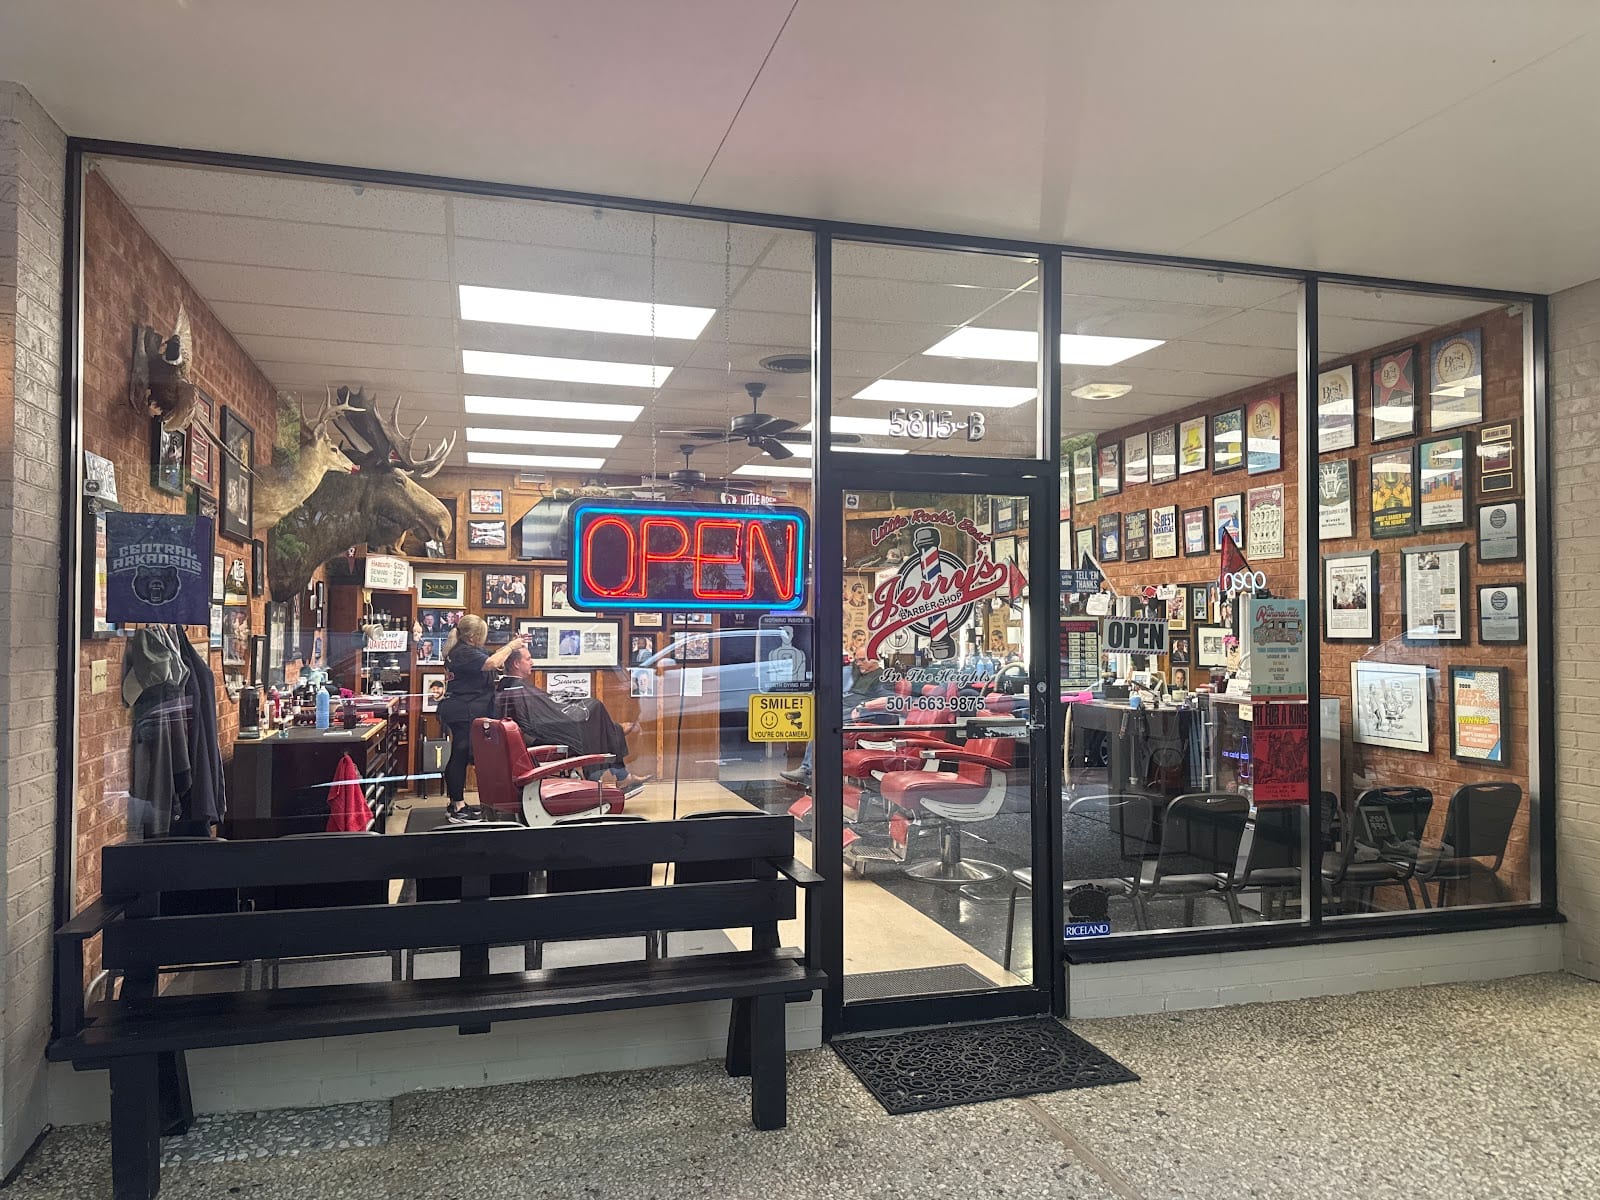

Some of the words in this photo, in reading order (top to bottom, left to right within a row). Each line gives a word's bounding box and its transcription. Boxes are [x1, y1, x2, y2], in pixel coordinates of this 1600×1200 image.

[889, 407, 985, 441] 5815-B
[740, 493, 760, 505] LITTLE
[1160, 513, 1175, 527] BEST
[871, 515, 908, 546] Little
[119, 543, 198, 561] CENTRAL
[582, 516, 796, 600] OPEN
[112, 554, 203, 573] ARKANSAS
[1076, 570, 1088, 580] TELL
[867, 550, 1008, 632] Jerry's
[900, 601, 938, 620] BARBER
[938, 591, 962, 607] SHOP
[1108, 621, 1164, 650] OPEN
[880, 668, 902, 682] In
[906, 668, 933, 682] The
[935, 668, 990, 688] Heights
[760, 698, 804, 710] SMILE!
[886, 697, 985, 711] 501-663-9875
[775, 730, 784, 738] ON
[785, 730, 808, 738] CAMERA
[1066, 924, 1109, 936] RICELAND
